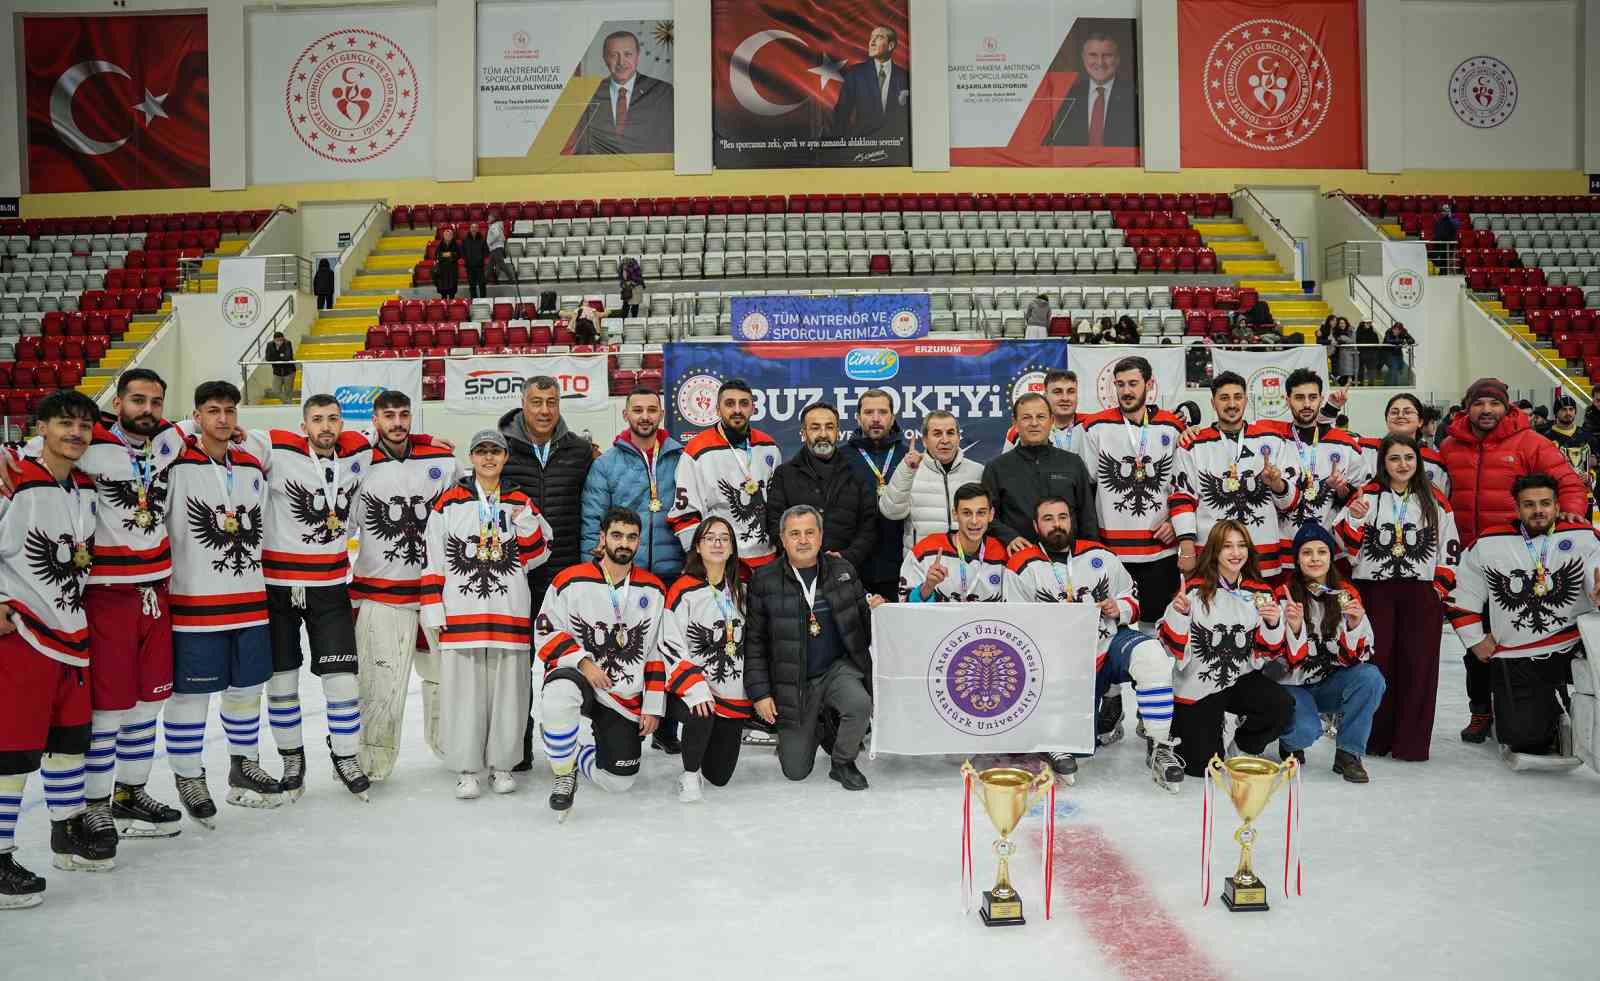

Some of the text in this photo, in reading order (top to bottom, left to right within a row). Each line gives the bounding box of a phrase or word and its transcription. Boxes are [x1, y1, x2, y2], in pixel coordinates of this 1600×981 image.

[772, 312, 887, 326] TÜM ANTRENÖR VE
[772, 326, 887, 340] SPORCULARIMIZA
[915, 345, 961, 353] ERZURUM
[936, 625, 1038, 674] Atatürk Üniversitesi
[936, 689, 1038, 730] Atatürk University
